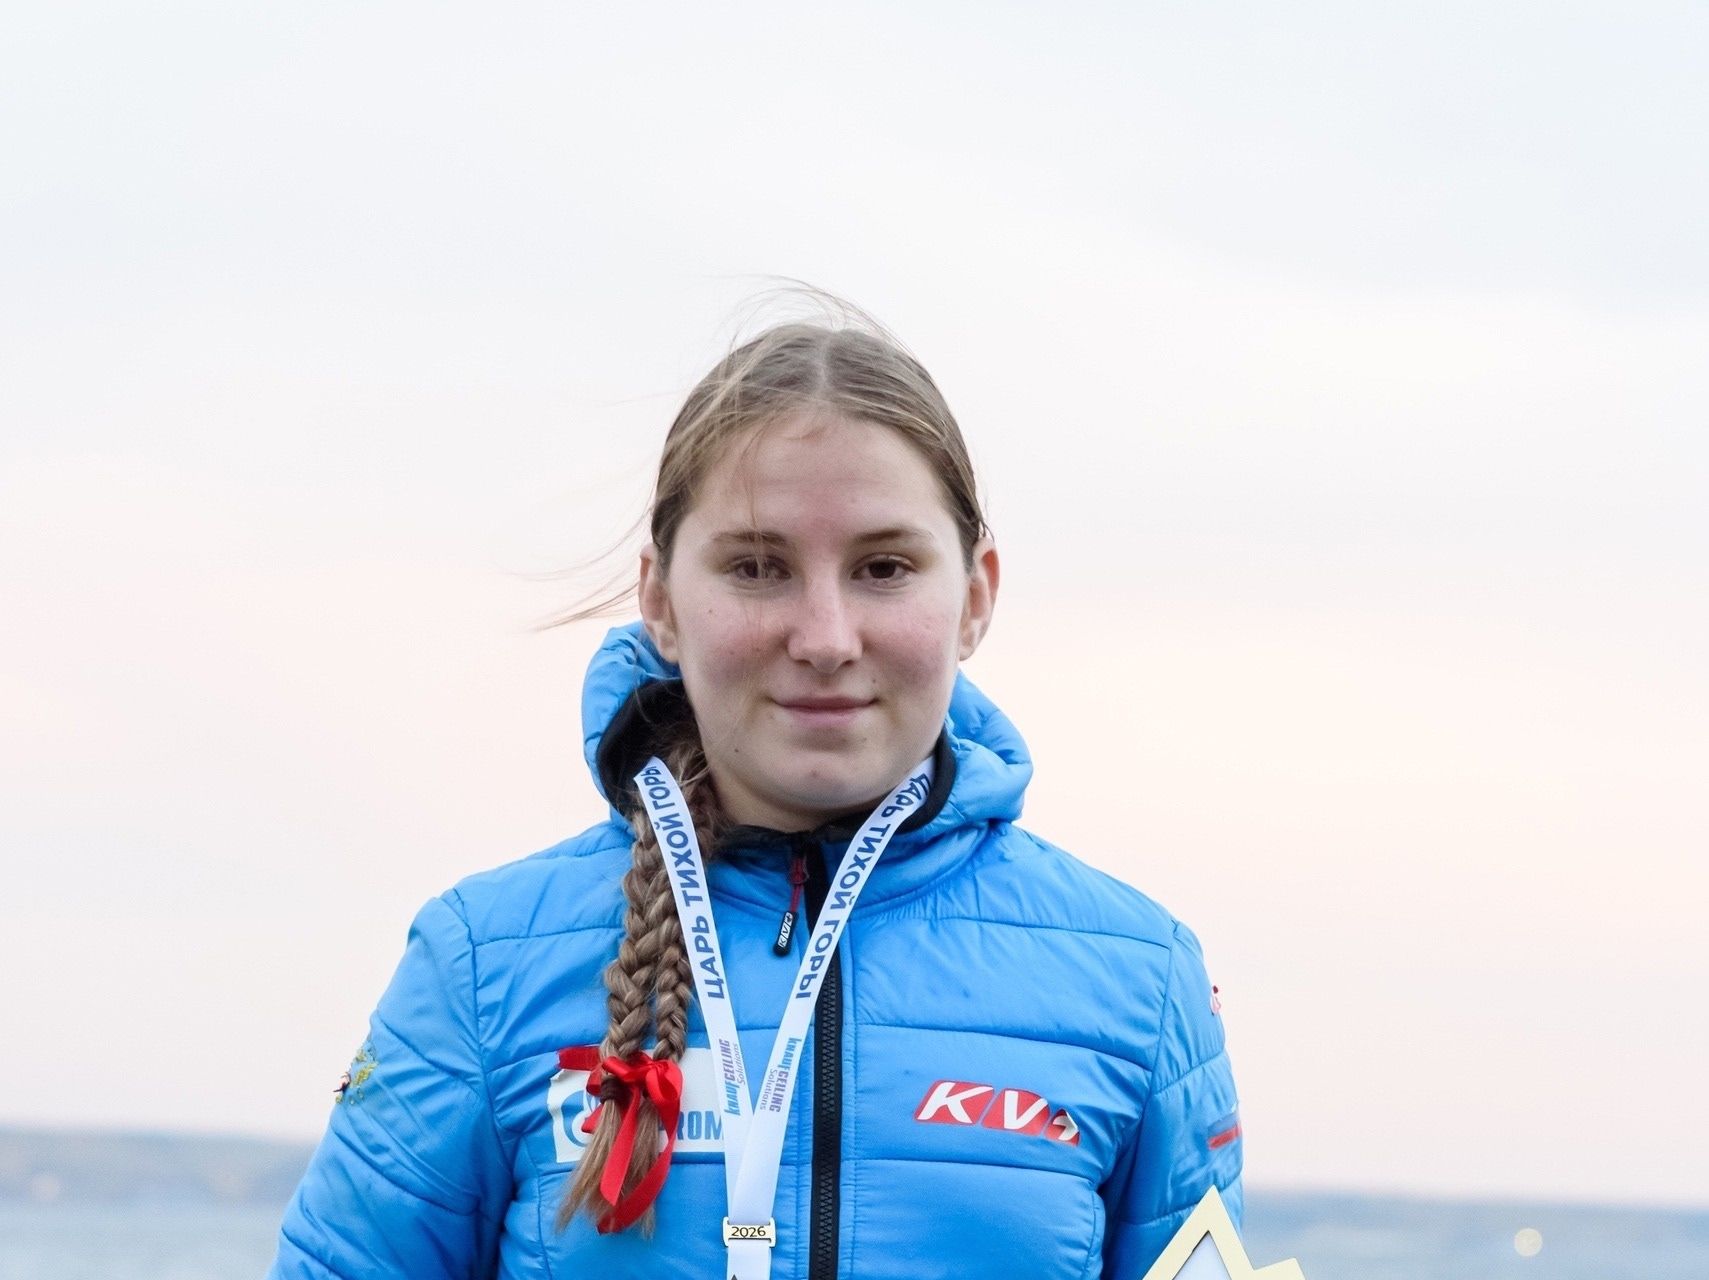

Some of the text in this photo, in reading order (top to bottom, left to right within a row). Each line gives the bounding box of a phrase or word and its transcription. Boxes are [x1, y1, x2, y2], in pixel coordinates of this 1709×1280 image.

[654, 812, 704, 908] ТИХОЙ
[795, 773, 931, 999] ЦАРЬ ТИХОЙ ГОРЫ
[691, 915, 725, 1000] ЦАРЬ
[731, 1226, 766, 1238] 2026
